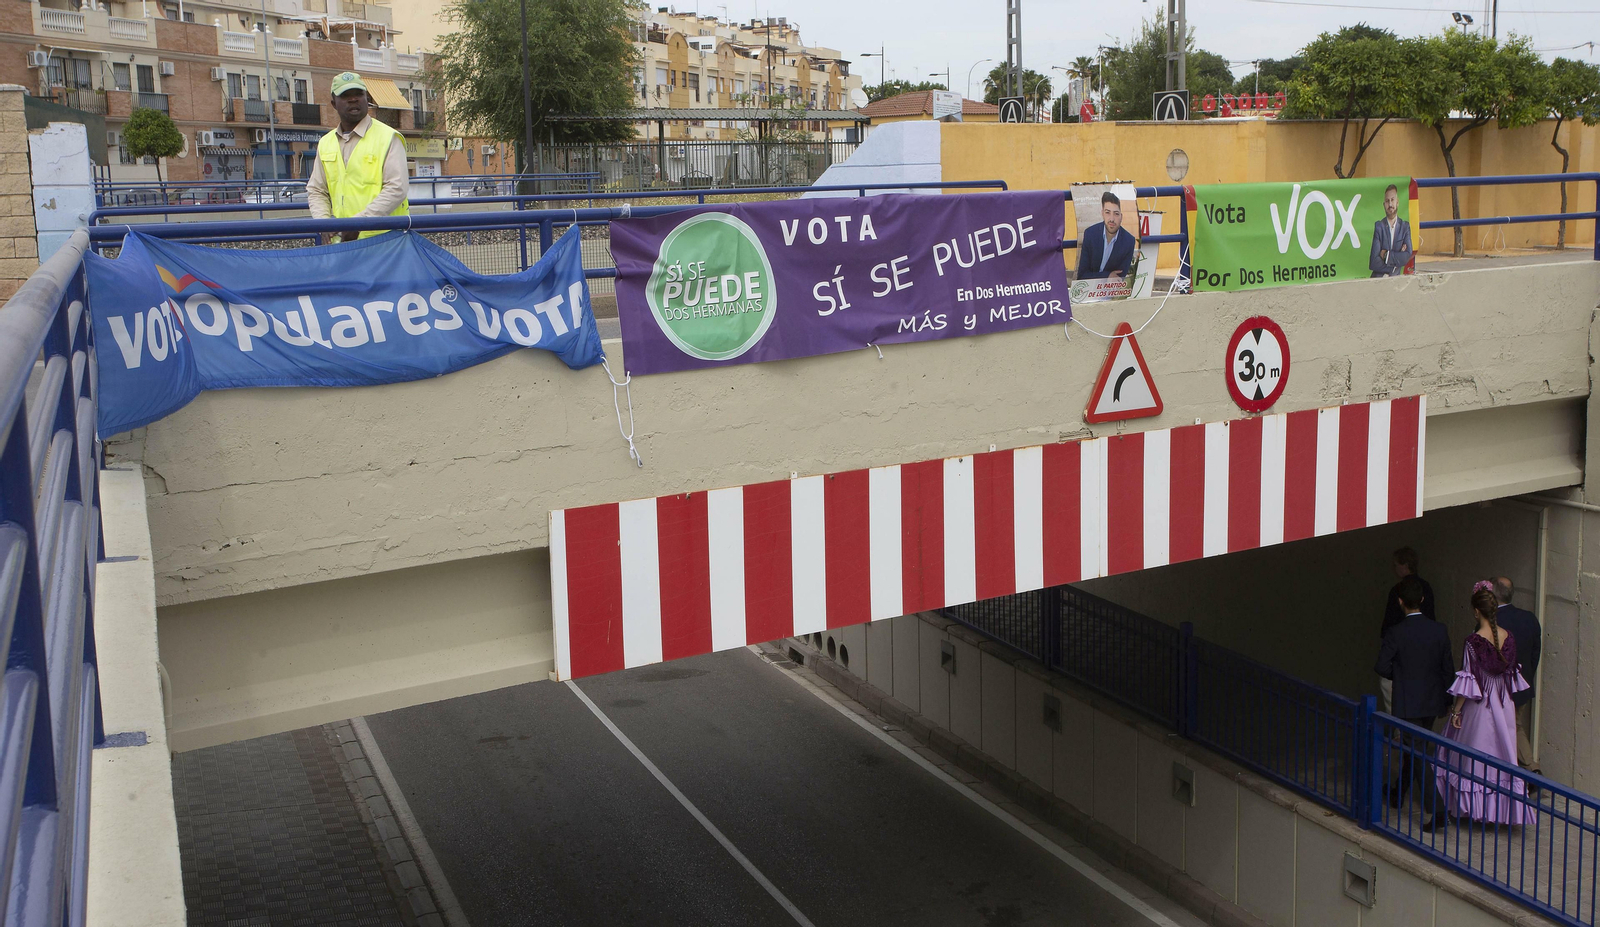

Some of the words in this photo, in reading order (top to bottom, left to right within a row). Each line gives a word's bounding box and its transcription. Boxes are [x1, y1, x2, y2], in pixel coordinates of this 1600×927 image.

[267, 132, 300, 141] Atoescuela
[1203, 203, 1246, 225] Vota
[1270, 184, 1361, 260] VOX
[780, 214, 878, 246] VOTA
[688, 260, 707, 281] SE
[812, 264, 851, 317] SÍ
[869, 255, 913, 298] SE
[932, 214, 1037, 277] PUEDE
[1195, 268, 1231, 287] Por
[1240, 267, 1264, 286] Dos
[1273, 263, 1337, 283] Hermanas
[664, 271, 762, 308] PUEDE
[957, 287, 974, 302] En
[976, 285, 994, 300] Dos
[996, 280, 1052, 298] Hermanas
[1103, 281, 1126, 289] PARTIDO
[664, 307, 690, 321] DOS
[693, 299, 763, 318] HERMANAS
[898, 309, 948, 334] MÁS
[989, 300, 1066, 324] MEJOR
[1271, 367, 1280, 378] m
